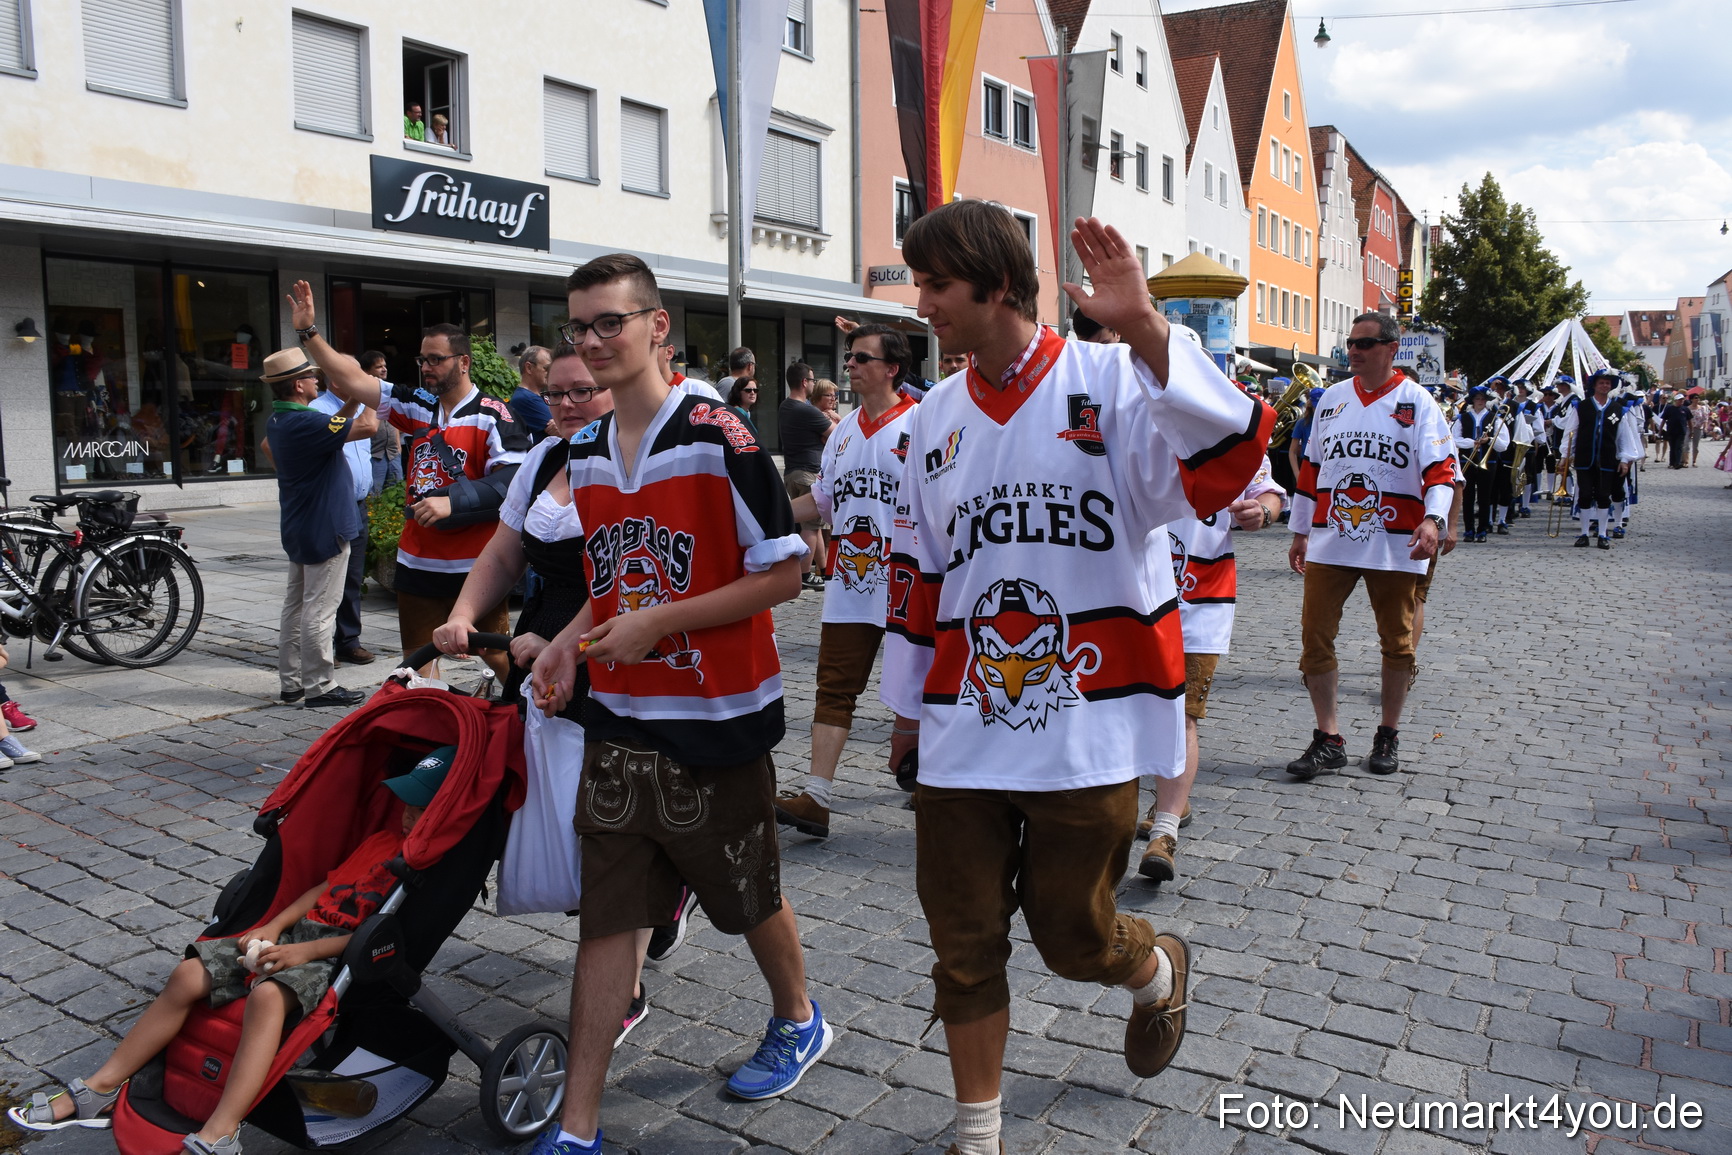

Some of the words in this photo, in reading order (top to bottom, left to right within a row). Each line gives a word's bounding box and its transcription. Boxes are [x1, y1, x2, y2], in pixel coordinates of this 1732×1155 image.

[1399, 335, 1430, 348] apelle
[1332, 431, 1392, 443] NEUMARKT
[586, 516, 694, 598] Eagles
[371, 942, 396, 957] Britax
